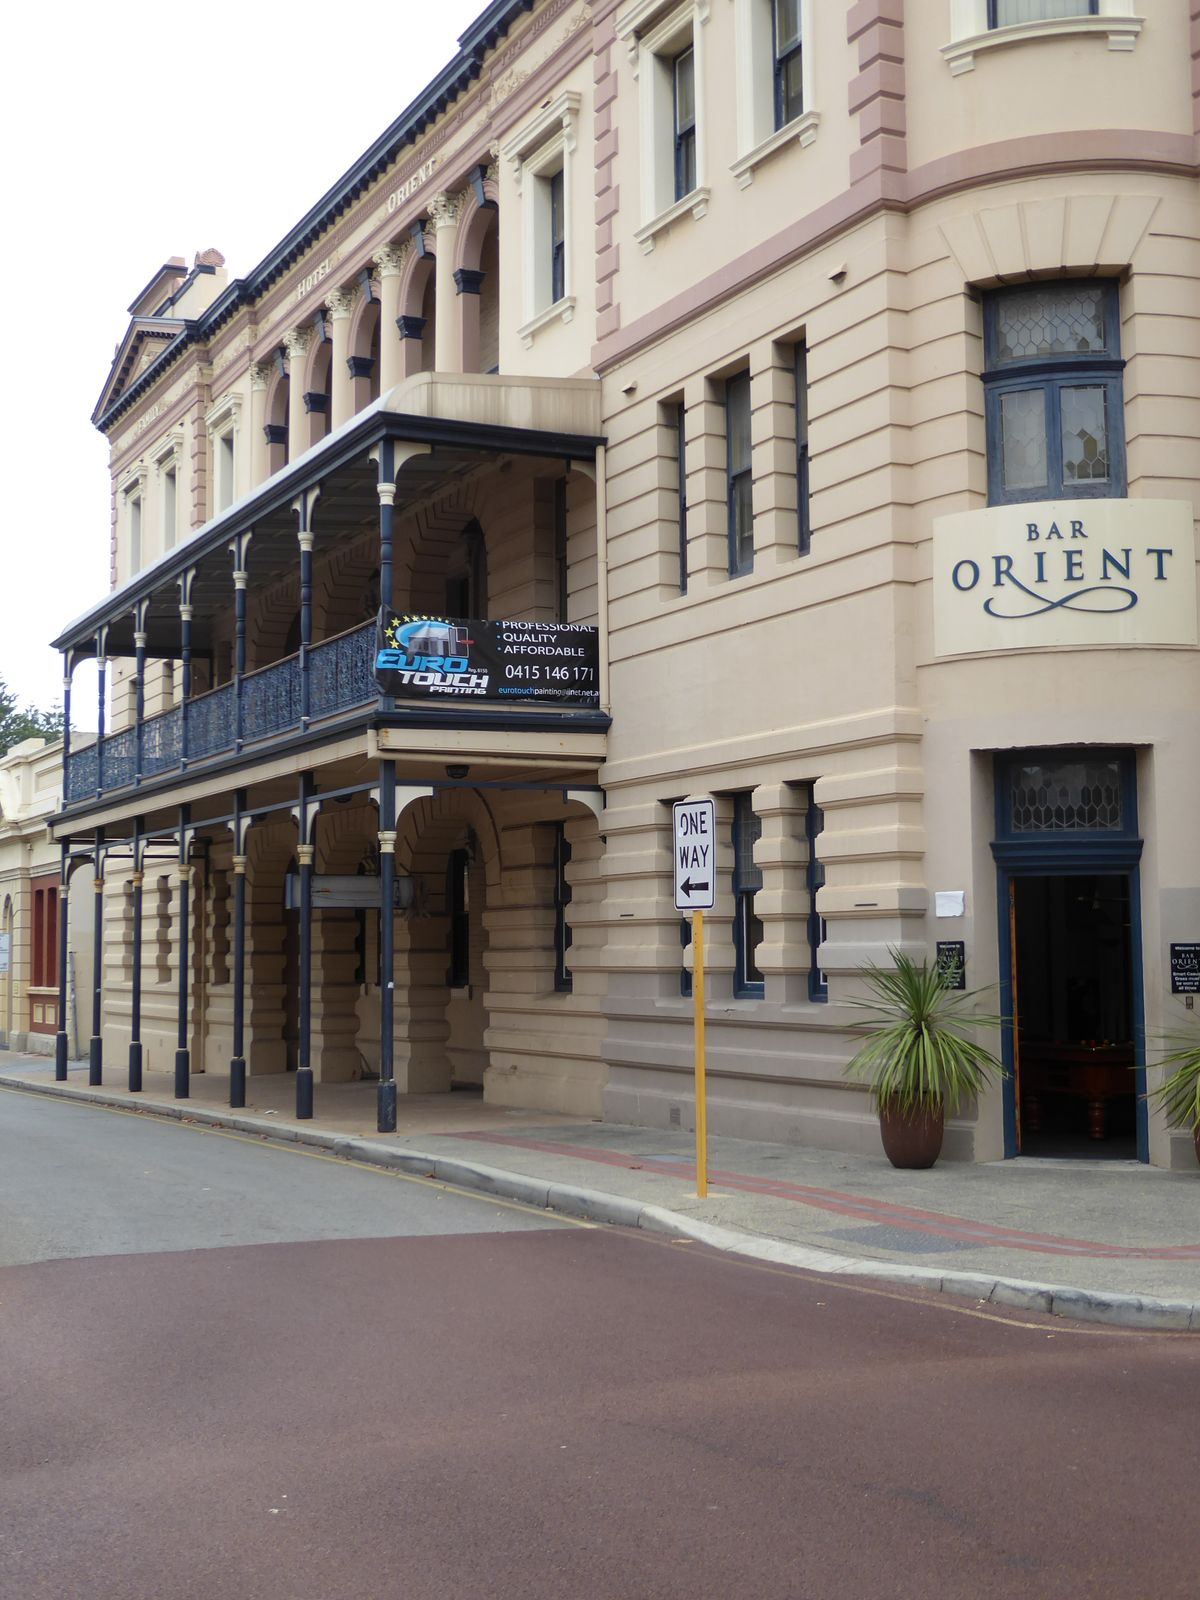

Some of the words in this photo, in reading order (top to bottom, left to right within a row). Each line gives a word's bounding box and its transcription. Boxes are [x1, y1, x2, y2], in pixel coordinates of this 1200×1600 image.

[297, 258, 334, 300] HOTEL
[386, 157, 436, 213] ORIENT
[1026, 520, 1088, 541] BAR
[952, 548, 1173, 618] ORIENT
[502, 621, 596, 632] PROFESSIONAL
[503, 633, 557, 643] QUALITY
[504, 645, 585, 657] AFFORDABLE
[376, 649, 469, 675] EURO
[398, 670, 489, 687] TOUCH
[505, 664, 540, 679] 0415
[544, 666, 569, 680] 146
[573, 667, 594, 681] 171
[429, 686, 487, 695] PAINTING
[680, 811, 708, 836] ONE
[680, 844, 709, 869] WAY
